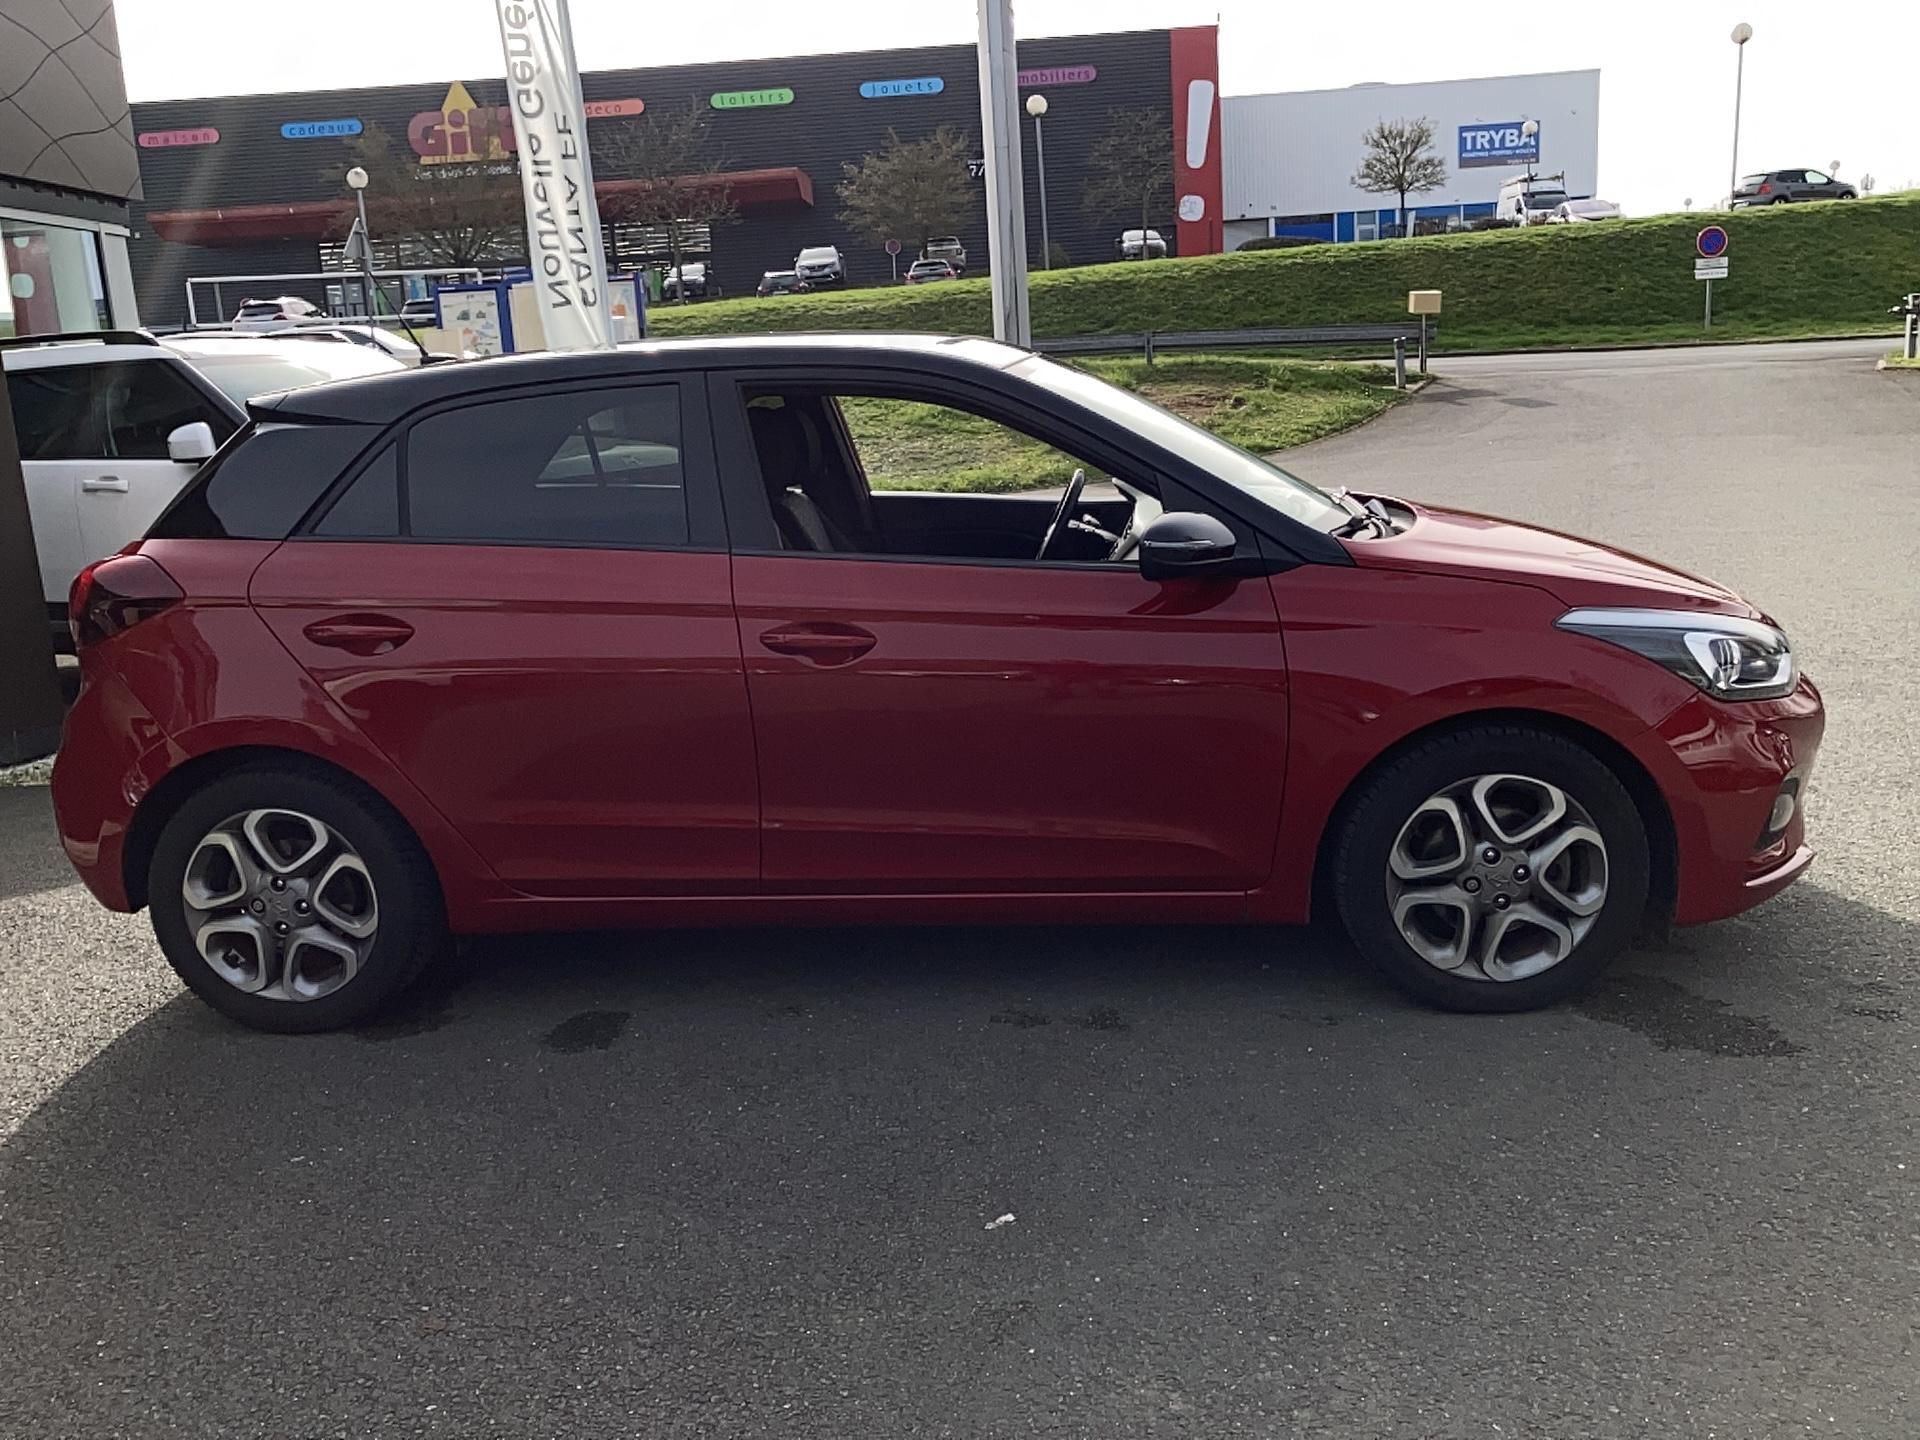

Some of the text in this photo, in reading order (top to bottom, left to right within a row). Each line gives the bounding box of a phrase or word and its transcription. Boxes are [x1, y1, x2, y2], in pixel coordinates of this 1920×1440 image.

[1019, 69, 1090, 84] mobiliers
[872, 81, 934, 97] jouets
[720, 93, 784, 106] loisirs
[289, 123, 355, 136] cadeaux
[147, 132, 210, 145] maison
[1462, 128, 1536, 150] TRYBA
